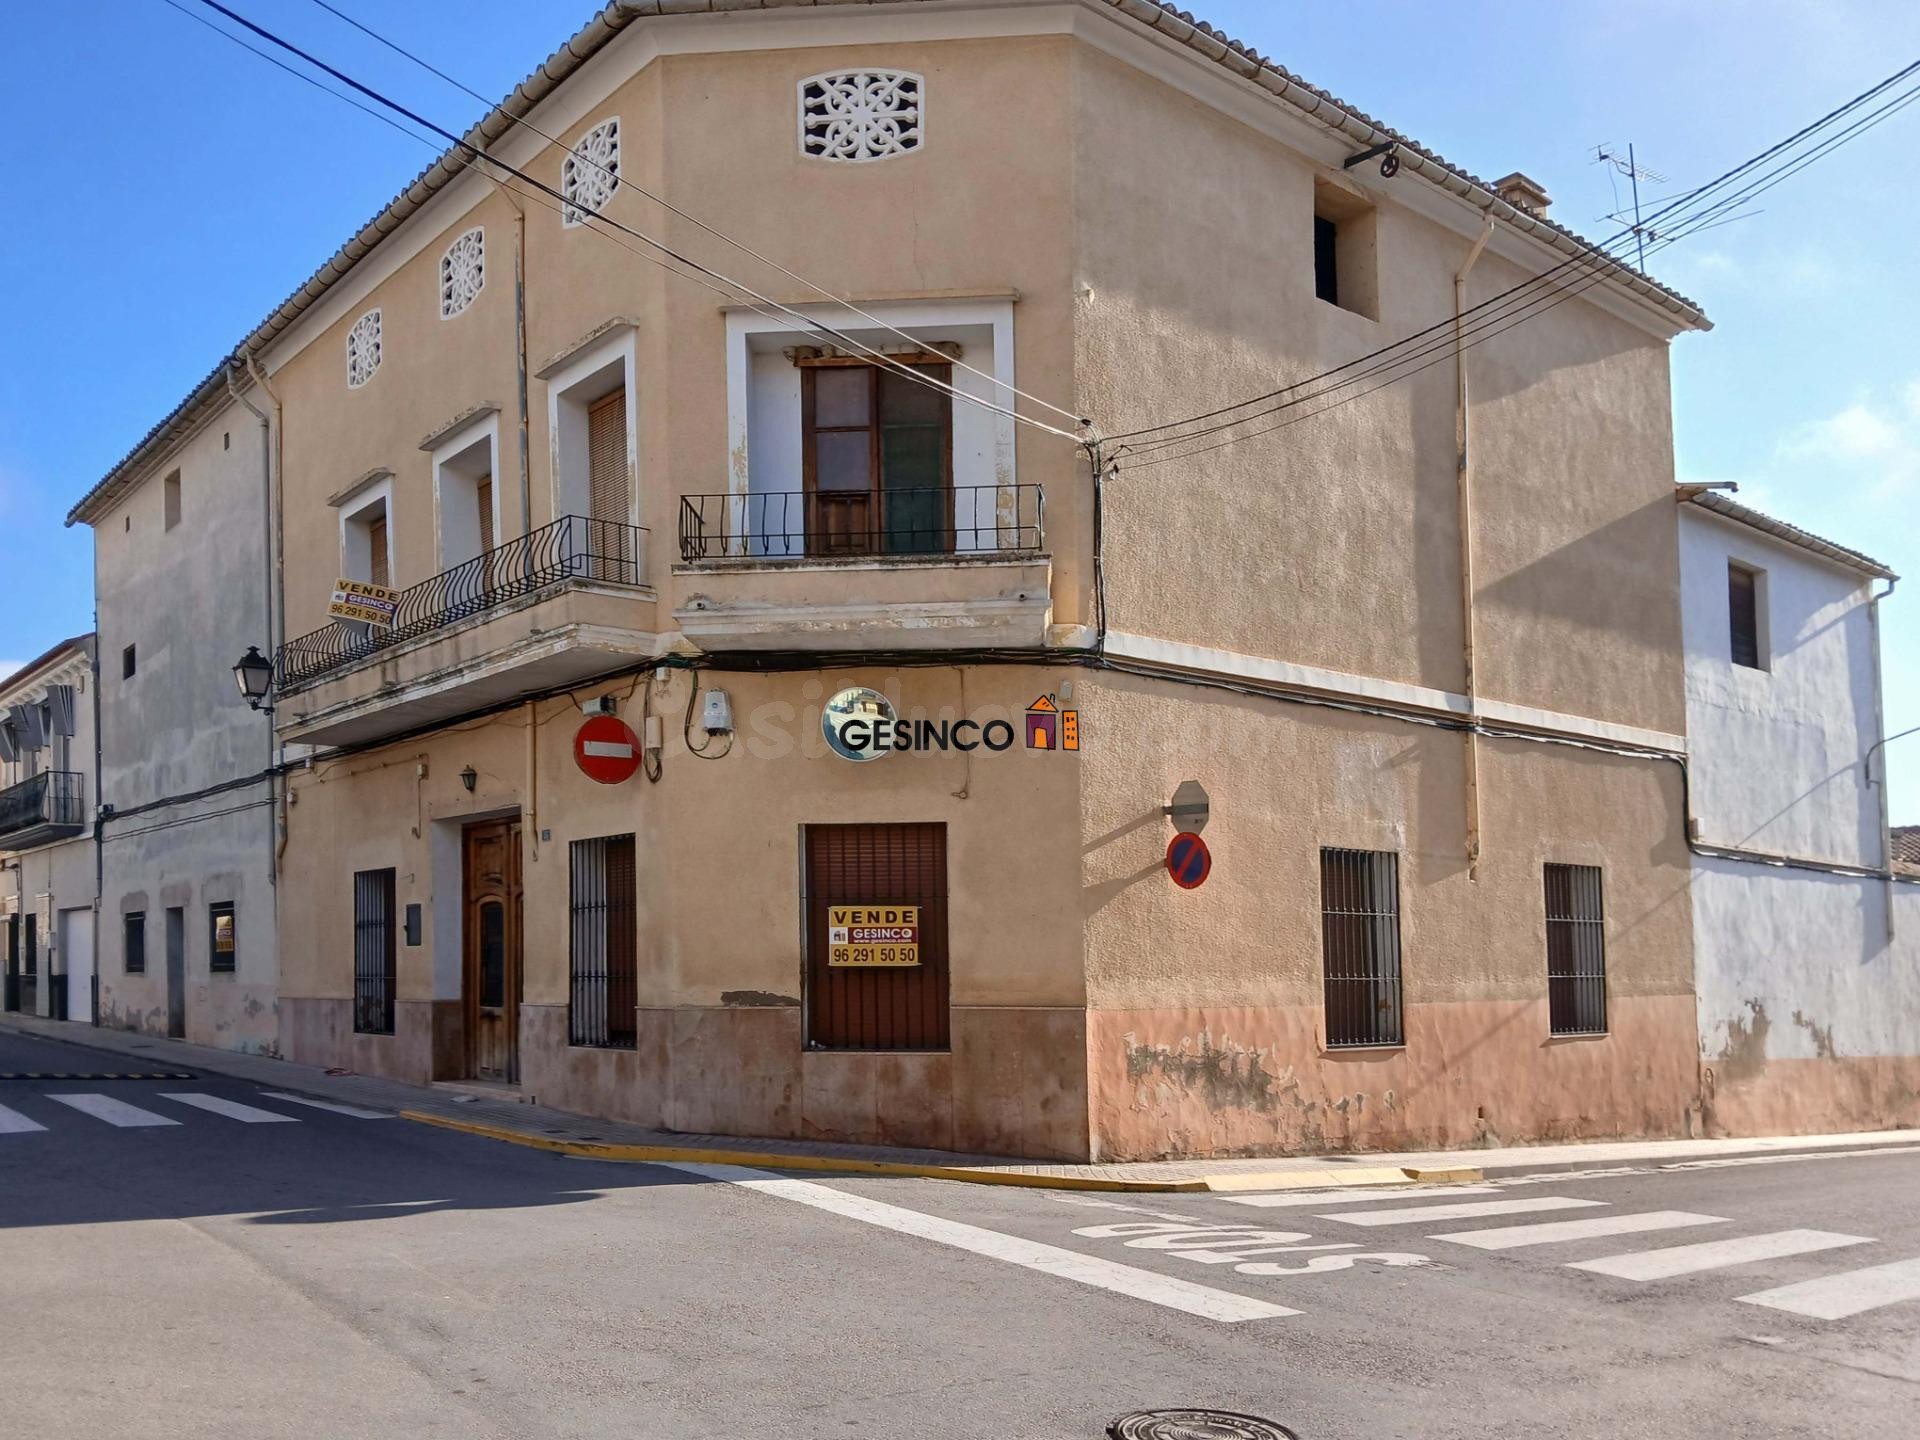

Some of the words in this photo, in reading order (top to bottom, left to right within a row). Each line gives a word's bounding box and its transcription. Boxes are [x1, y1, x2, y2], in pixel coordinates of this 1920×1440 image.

[339, 582, 398, 602] VENDE
[349, 595, 393, 610] GESINCO
[331, 605, 344, 614] 96
[345, 606, 362, 617] 291
[365, 611, 377, 620] 50
[379, 616, 391, 624] 50
[834, 911, 913, 924] VENDE
[853, 929, 912, 938] GESINCO
[833, 948, 849, 962] 96
[853, 948, 875, 962] 291
[880, 948, 896, 962] 50
[899, 948, 915, 962] 50
[1070, 1223, 1434, 1276] STOP
